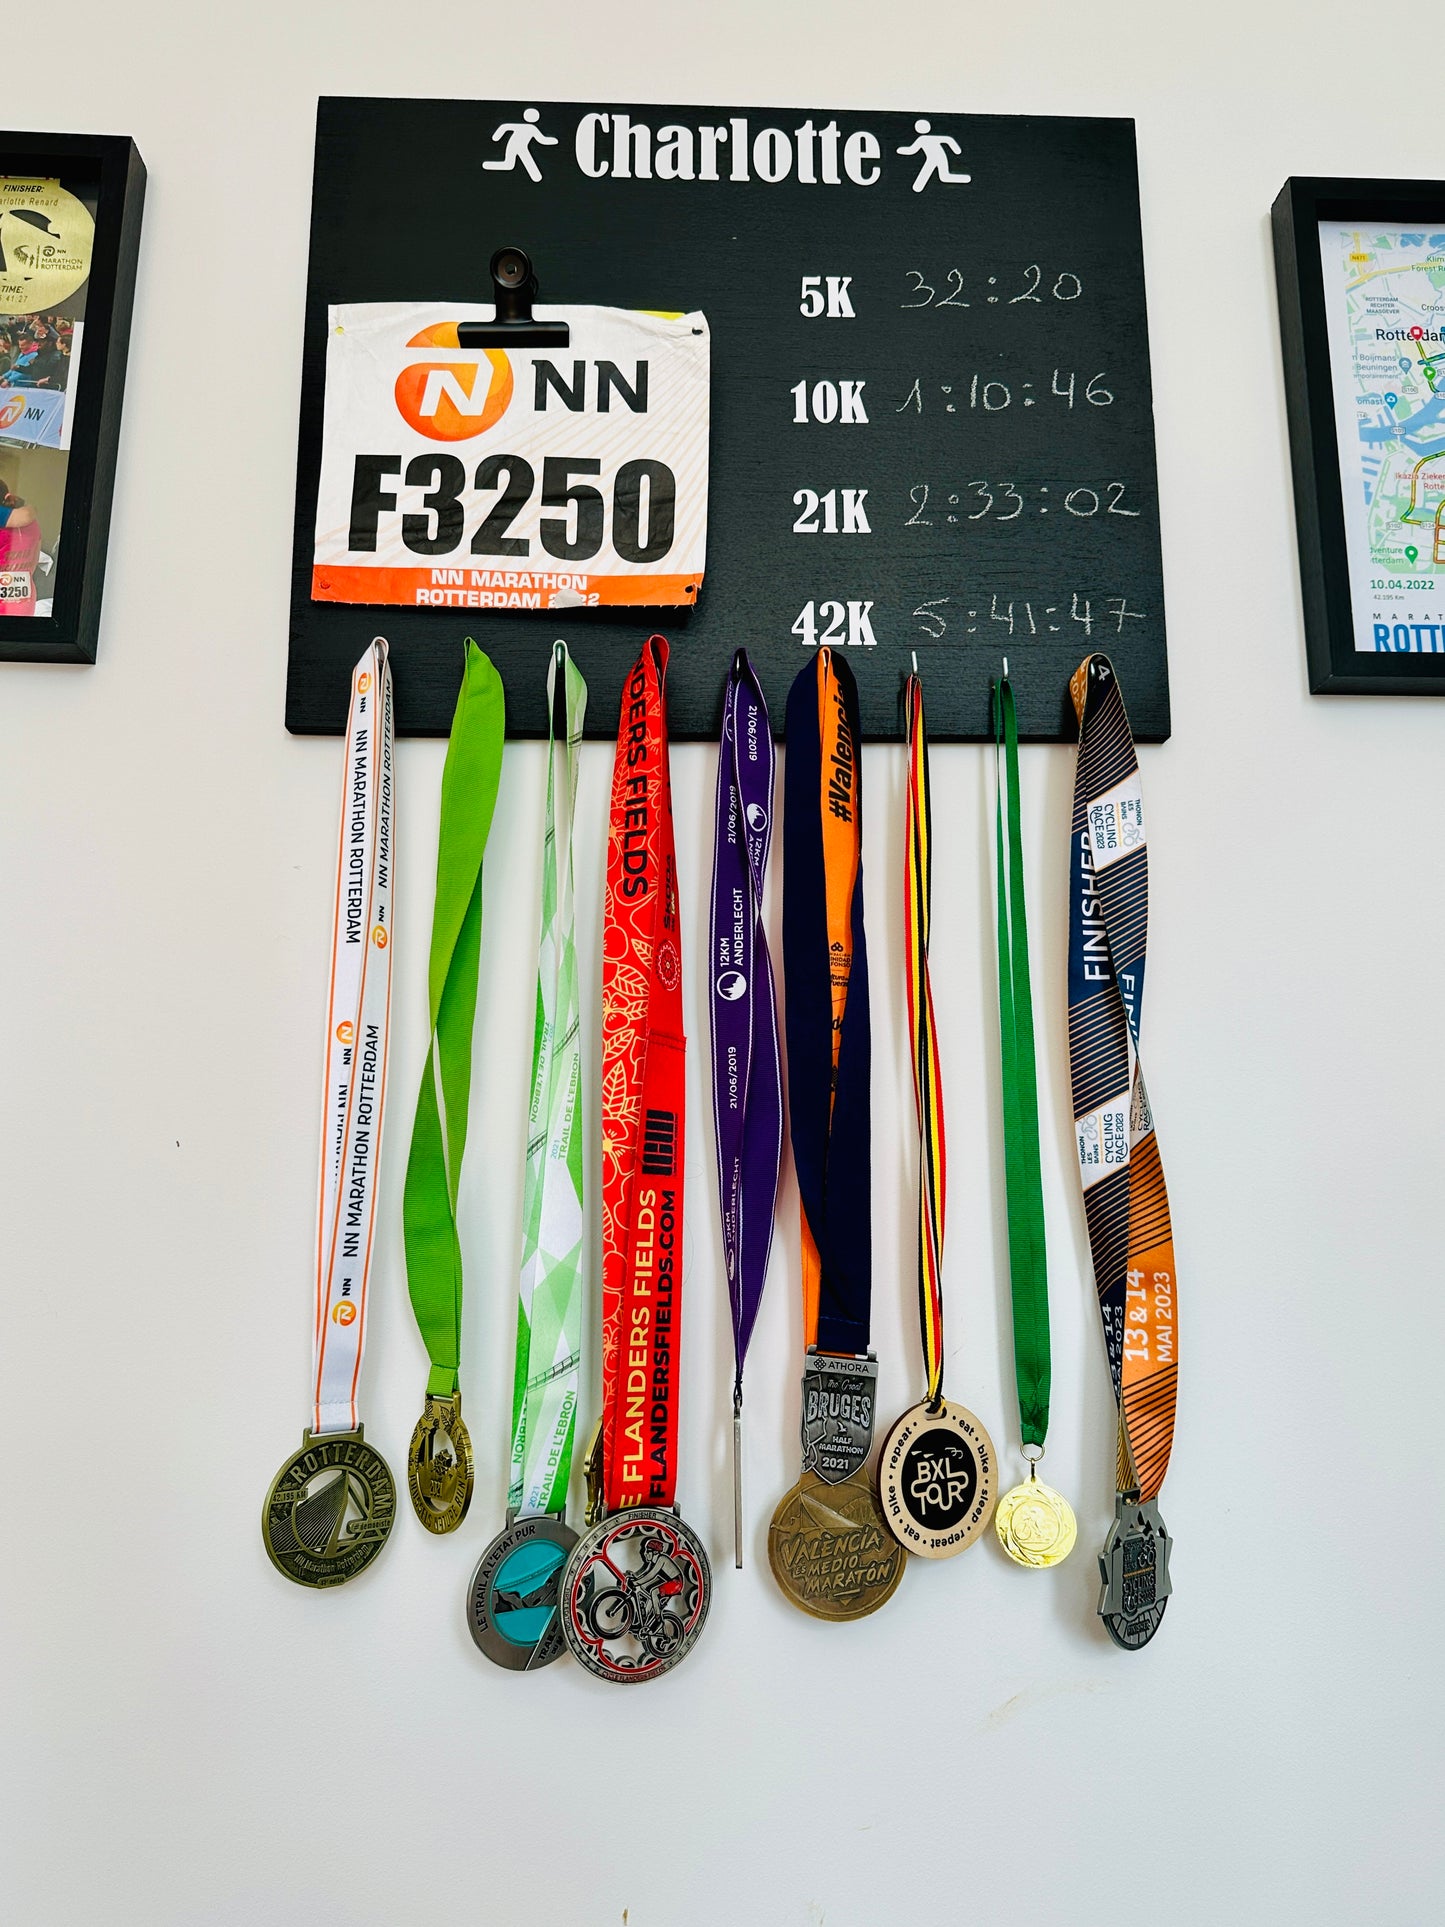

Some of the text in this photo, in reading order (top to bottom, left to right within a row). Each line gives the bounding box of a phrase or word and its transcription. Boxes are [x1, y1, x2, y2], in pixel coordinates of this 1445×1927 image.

[575, 113, 881, 186] Charlotte
[3, 184, 45, 193] FINISHER:
[799, 276, 856, 318] 5K
[901, 265, 1083, 308] 32:20
[532, 360, 649, 413] NN
[790, 380, 869, 423] 10K
[896, 369, 1114, 413] 1:10:46
[24, 408, 45, 421] NN
[347, 453, 677, 564] F3250
[792, 489, 871, 533] 21K
[905, 481, 1141, 526] 2:33:02
[416, 589, 600, 609] ROTTERDAM 222
[431, 569, 588, 591] NN MARATHON
[1370, 579, 1435, 591] 10.04.2022
[791, 601, 877, 646] 42K
[912, 593, 1147, 638] 5:41:47
[359, 696, 367, 714] NN
[747, 705, 758, 762] 21/06/2019
[346, 729, 367, 944] NN MARATHON ROTTERDAM
[380, 773, 391, 862] MARATHON
[728, 785, 737, 845] 21/06/2019
[1090, 804, 1106, 850] RACE 2023
[1103, 803, 1117, 849] CYCLING
[623, 778, 649, 898] FIELDS
[378, 864, 388, 889] NN
[378, 905, 385, 922] NN
[732, 887, 744, 966] ANDERLECHT
[720, 937, 730, 968] 12KM
[343, 1048, 352, 1065] NN
[728, 1046, 737, 1109] 21/06/2019
[557, 1052, 579, 1160] TRAIL DE L'EBRON
[342, 1025, 379, 1257] NN MARATHON ROTTERDAM
[550, 1138, 560, 1160] 2021
[1104, 1113, 1113, 1164] CYCLING
[1115, 1112, 1128, 1164] RACE 2023
[342, 1278, 352, 1297] NN
[623, 1189, 656, 1483] FLANDERS FIELDS
[1102, 1303, 1112, 1336] 14
[1114, 1305, 1123, 1355] 2023
[1123, 1268, 1149, 1362] 13 & 14
[1153, 1271, 1173, 1363] MAI 2023
[650, 1189, 676, 1500] FLANDERSFIELDS.COM
[828, 1361, 869, 1373] ATHORA
[807, 1390, 871, 1429] BRUGES
[536, 1390, 576, 1510] TRAIL DE L'EBRON
[818, 1442, 864, 1455] MARATHON
[832, 1435, 853, 1445] HALF
[290, 1443, 394, 1519] ROTTERDAM
[821, 1456, 849, 1470] 2021
[888, 1419, 989, 1550] eat bike sleep repeat eat bike repeat
[917, 1457, 968, 1483] BXL
[528, 1485, 540, 1509] 2021
[911, 1480, 965, 1516] TOUR
[475, 1524, 536, 1633] LE TRAIL A L'ETAT PUR
[805, 1561, 892, 1596] MARATÓN
[808, 1553, 860, 1578] MEDIO
